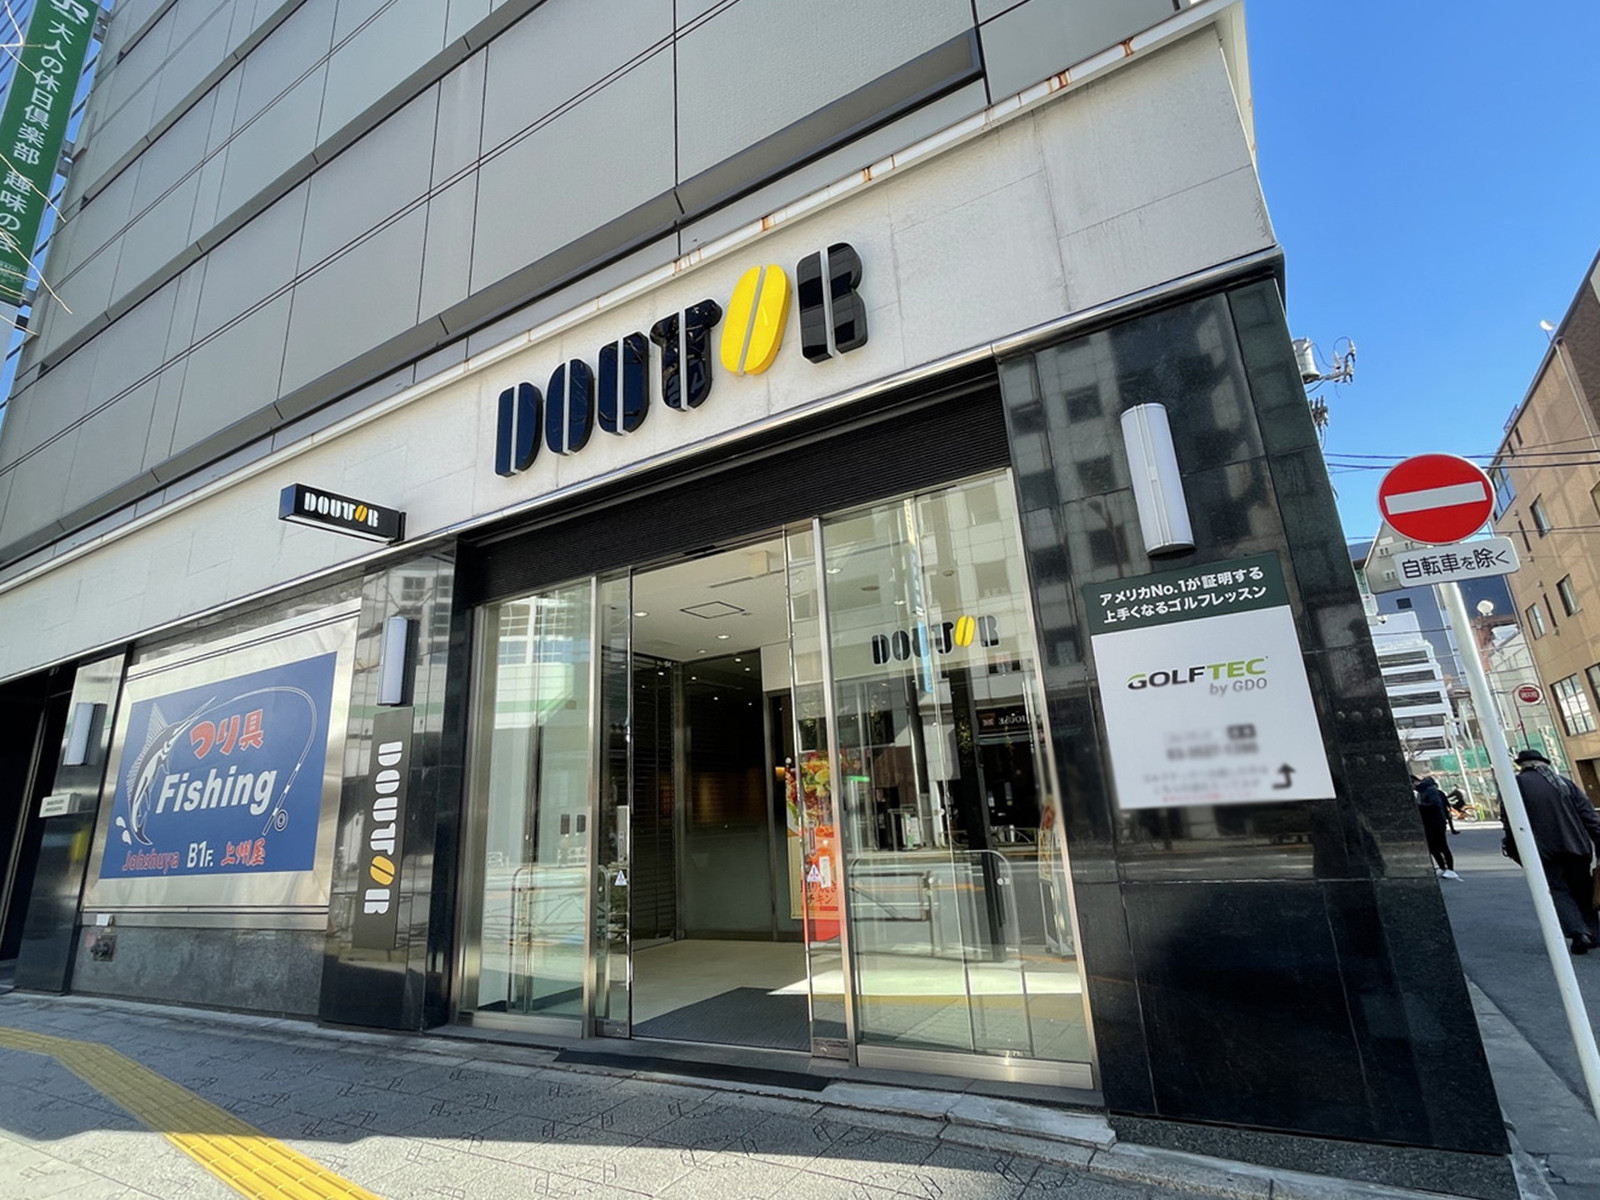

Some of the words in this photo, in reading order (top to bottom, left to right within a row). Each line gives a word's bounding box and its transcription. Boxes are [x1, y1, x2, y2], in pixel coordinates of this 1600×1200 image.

[13, 20, 75, 165] 大人の休日倶楽部
[494, 241, 869, 478] DOUTOR
[303, 492, 379, 528] DOUTOR
[1402, 548, 1510, 579] 自転車を除く
[1100, 566, 1264, 607] アメリカNo.1が証明する
[1103, 585, 1267, 624] 上手くなるゴルフレッスン
[1127, 657, 1267, 690] GOLFTEC
[1209, 683, 1228, 698] by
[1232, 677, 1267, 692] GDO
[190, 708, 264, 760] つり具
[155, 765, 278, 816] Fishing
[363, 741, 403, 914] DOUTOR
[220, 837, 266, 867] 上州屋
